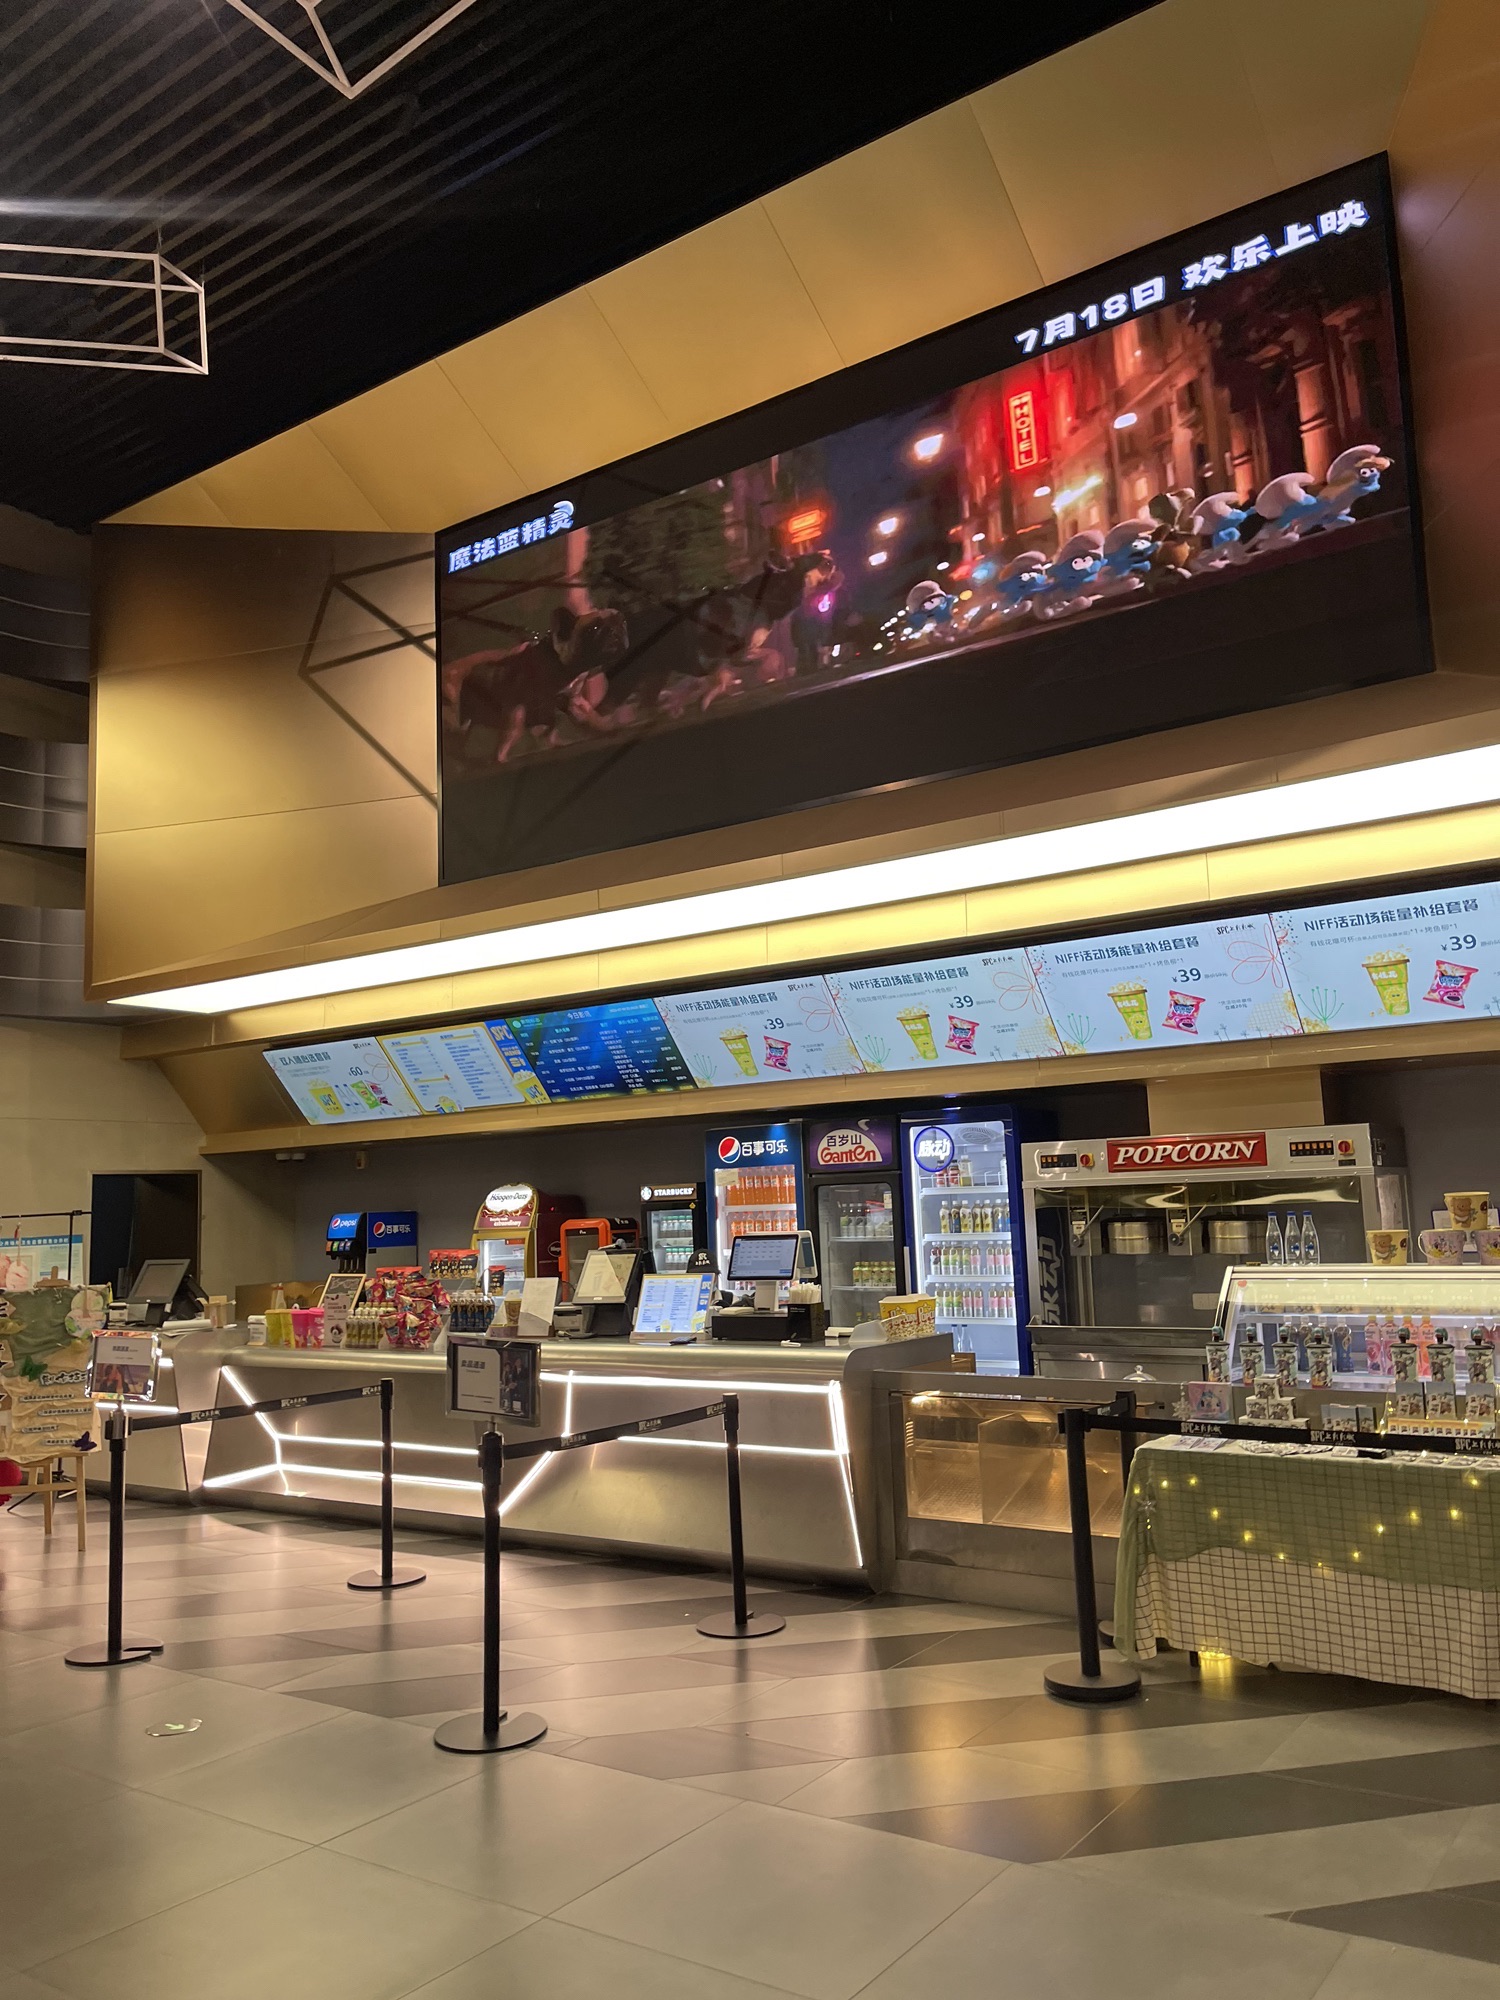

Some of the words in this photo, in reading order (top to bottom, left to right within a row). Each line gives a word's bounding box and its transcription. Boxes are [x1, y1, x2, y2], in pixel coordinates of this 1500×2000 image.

[1014, 277, 1165, 354] 7月18日
[1181, 199, 1370, 292] 欢乐上映
[1014, 403, 1034, 464] HOTEL
[447, 499, 575, 574] 魔法蓝精灵
[1303, 898, 1479, 932] NIFF活动场能量补给套餐
[1054, 935, 1200, 964] NIFF活动场能量补给套餐
[741, 1139, 788, 1157] 百事可乐
[826, 1134, 862, 1146] 百岁山
[917, 1139, 951, 1161] 脉动
[1113, 1140, 1258, 1165] POPCORN
[653, 1188, 694, 1197] STARBUCKS
